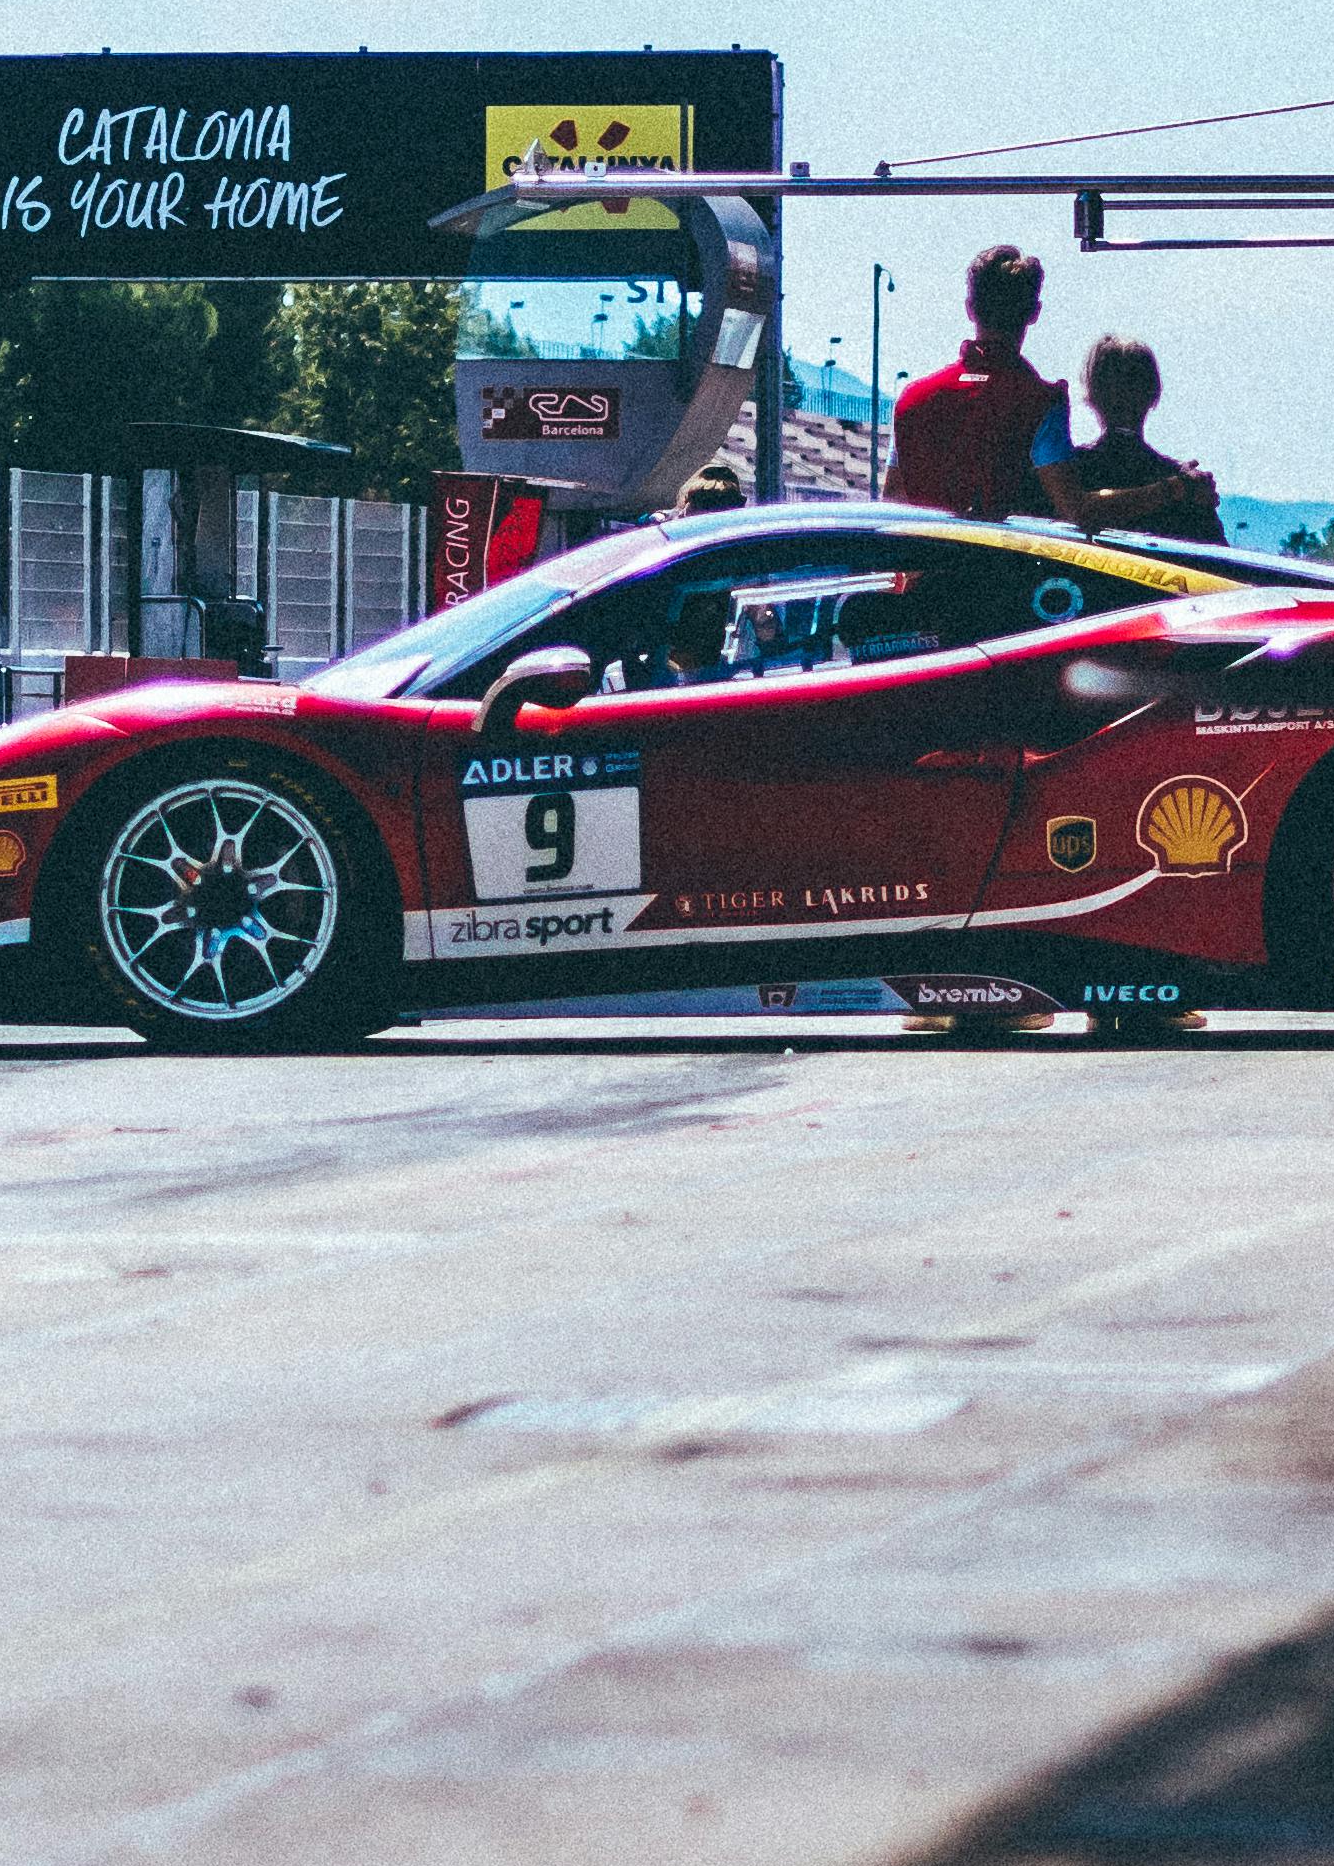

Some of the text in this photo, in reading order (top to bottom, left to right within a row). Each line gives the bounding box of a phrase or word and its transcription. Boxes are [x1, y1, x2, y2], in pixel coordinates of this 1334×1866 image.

[58, 104, 290, 166] CATALONIA
[1, 171, 348, 238] IS YOUR HOME
[542, 424, 604, 435] Barcelona
[445, 497, 470, 605] RACING
[1035, 541, 1189, 594] SINGHA
[1195, 719, 1334, 736] MASKINTRANSPORT A/S
[461, 753, 575, 785] ADLER
[525, 791, 576, 883] 9
[702, 891, 785, 910] TIGER
[805, 883, 929, 914] LAKRIDS
[918, 982, 1023, 1003] brembo
[1083, 984, 1181, 1002] IVECO
